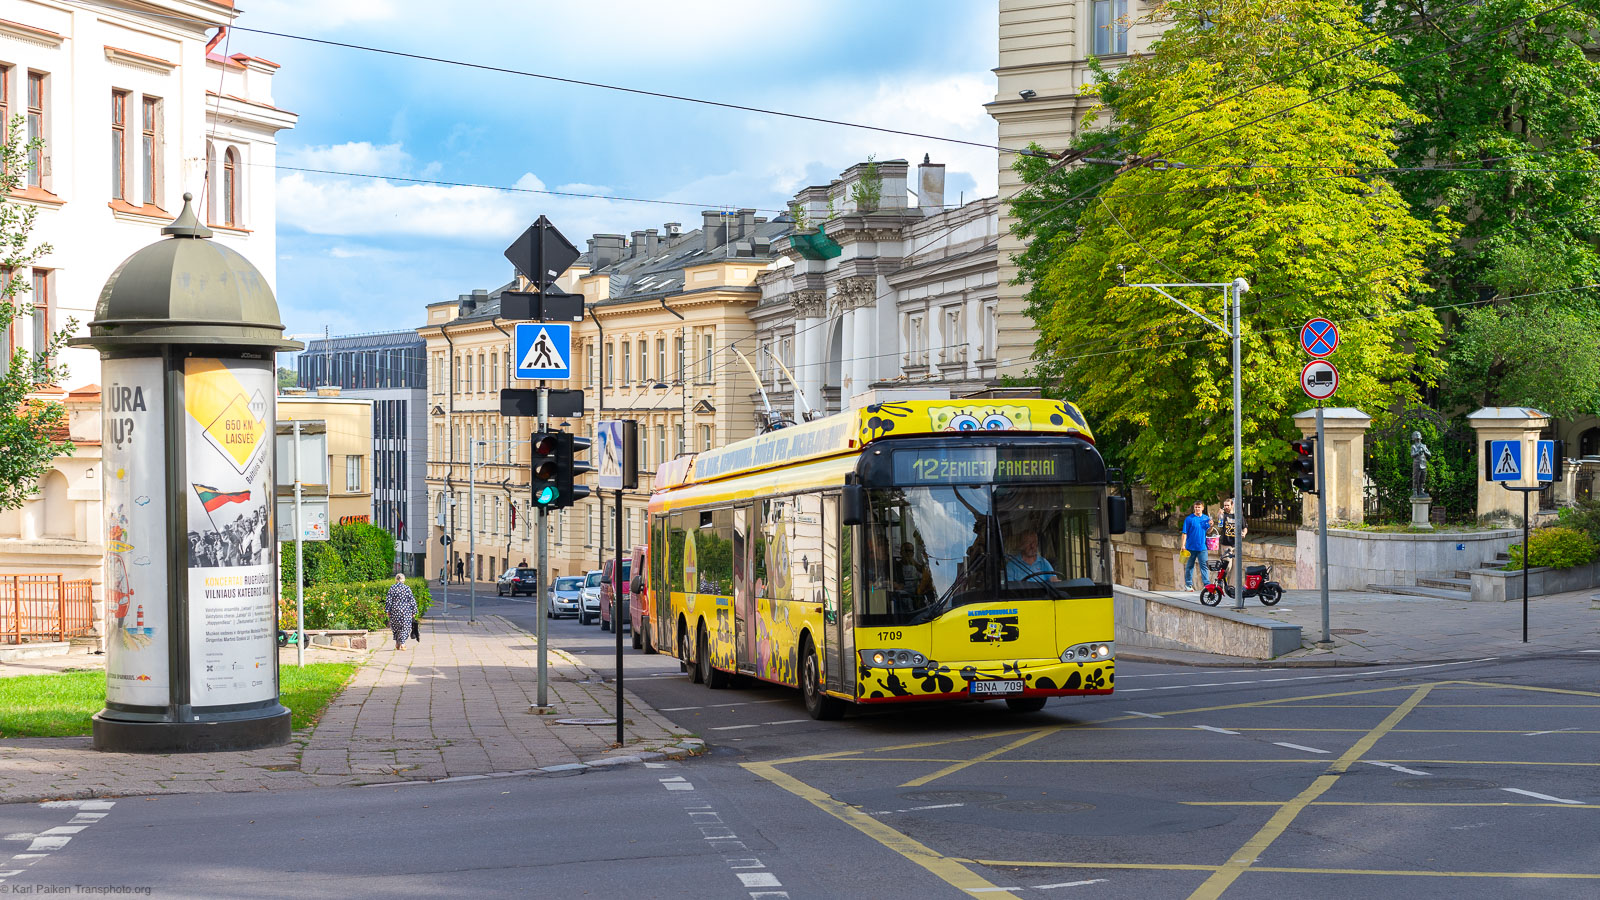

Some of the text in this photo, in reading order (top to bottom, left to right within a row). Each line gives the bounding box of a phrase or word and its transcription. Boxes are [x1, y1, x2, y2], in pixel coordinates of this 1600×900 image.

[225, 419, 254, 430] 650 KM
[912, 458, 1055, 479] 12 ŽEMIEJI PANERIAI
[205, 575, 243, 587] KONCERTAS
[205, 588, 236, 599] VILNIAUS
[237, 586, 261, 598] KATEDROS
[877, 630, 903, 641] 1709
[968, 616, 1020, 643] 25
[976, 682, 998, 692] BNA
[1004, 681, 1022, 691] 709
